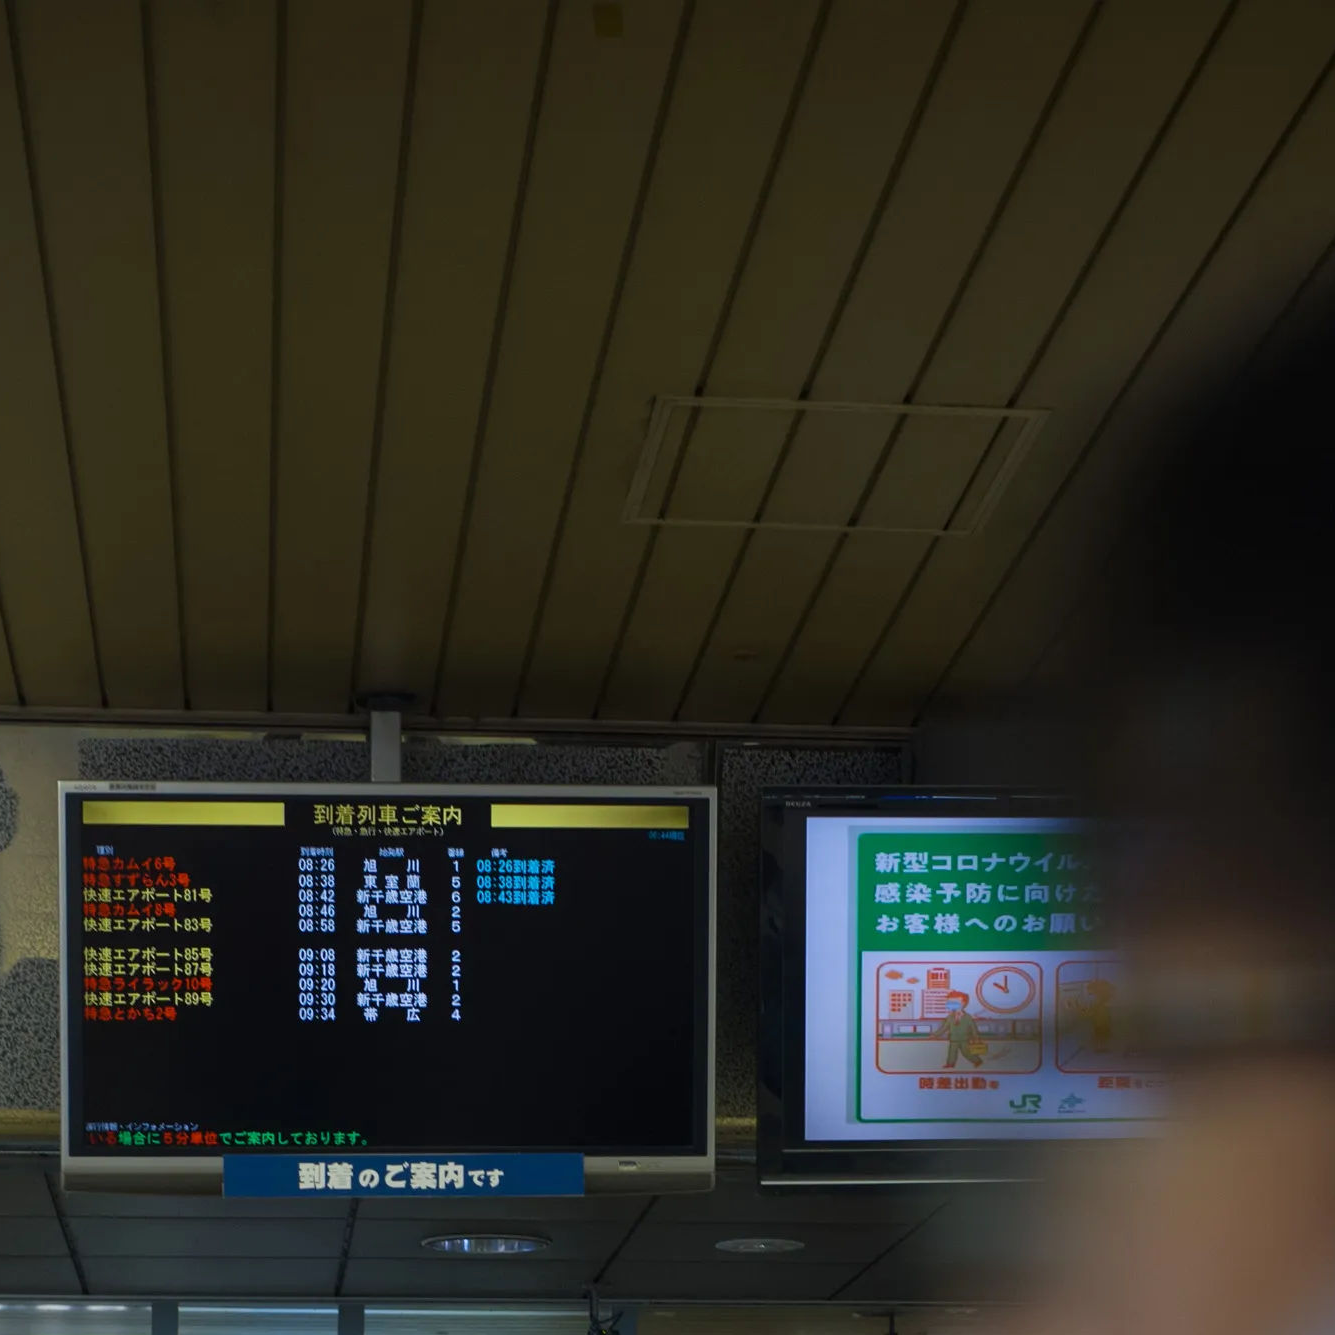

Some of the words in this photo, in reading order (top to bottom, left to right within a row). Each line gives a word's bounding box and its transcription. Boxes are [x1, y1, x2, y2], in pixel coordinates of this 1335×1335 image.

[313, 803, 462, 826] 到着列車ご案内
[82, 857, 176, 871] 特急カムイ6号
[298, 859, 336, 872] 08:26
[451, 860, 461, 872] 1
[476, 859, 556, 873] 08:26到着済
[874, 851, 1090, 874] 新型コロナウイル
[82, 873, 191, 886] 特急すずらん3号
[298, 874, 336, 888] 08:38
[451, 876, 461, 888] 5
[476, 874, 556, 888] 08:38到着済
[82, 888, 213, 902] 快速エアポート81号
[298, 890, 336, 903] 08:42
[356, 890, 428, 903] 新千歳空港
[451, 891, 461, 903] 6
[476, 890, 556, 904] 08:43到着済
[82, 903, 176, 917] 特急カムイ8号
[298, 905, 336, 918] 08:46
[451, 906, 461, 918] 2
[82, 918, 213, 932] 快速エアポート83号
[298, 920, 336, 933] 08:58
[356, 920, 428, 933] 新千歳空港
[451, 921, 461, 933] 5
[82, 948, 213, 961] 快速エアポート85号
[298, 949, 336, 962] 09:08
[356, 949, 428, 962] 新千歳空港
[451, 950, 461, 962] 2
[82, 963, 213, 976] 快速エアポート87号
[298, 964, 336, 978] 09:18
[356, 964, 428, 978] 新千歳空港
[451, 966, 461, 978] 2
[82, 978, 213, 991] 特急ライラック10号
[298, 979, 336, 992] 09:20
[451, 980, 461, 992] 1
[82, 993, 213, 1006] 快速エアポート89号
[298, 994, 336, 1008] 09:30
[356, 994, 428, 1008] 新千歳空港
[451, 996, 461, 1008] 2
[82, 1008, 177, 1021] 特急とかち2号
[298, 1009, 336, 1022] 09:34
[451, 1010, 461, 1022] 4
[1009, 1094, 1042, 1109] JR
[297, 1161, 505, 1190] 到着のご案内です
